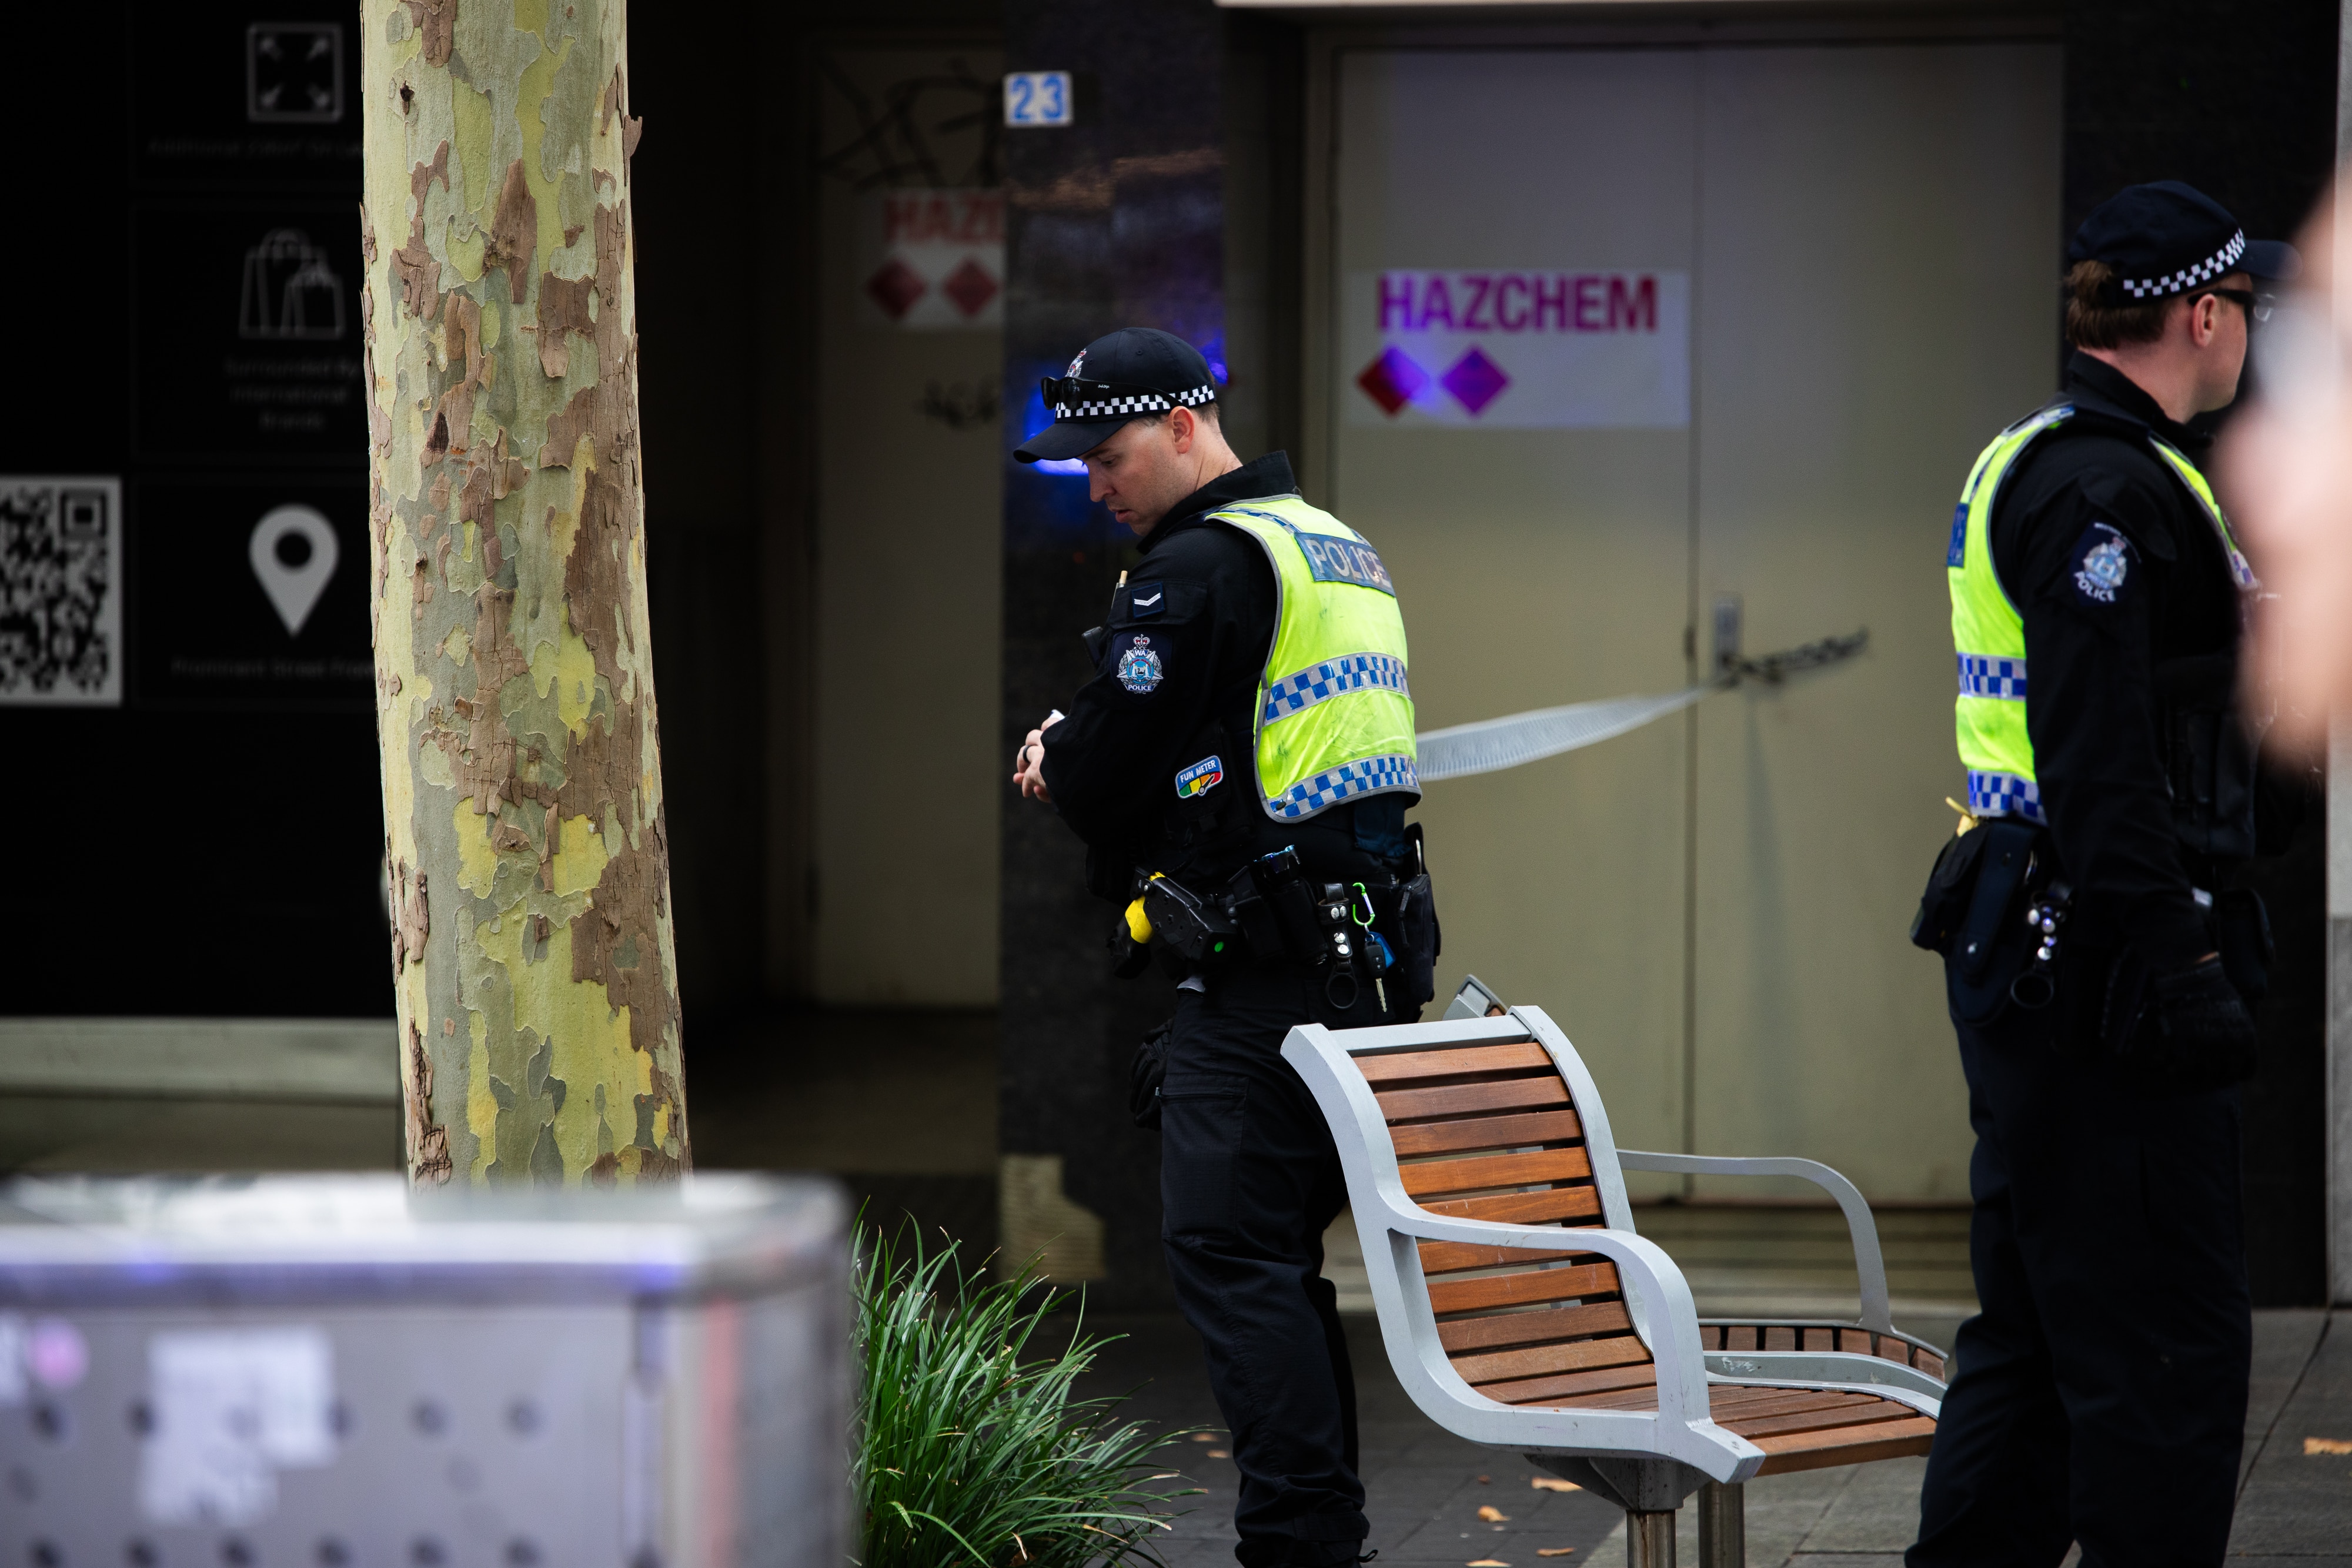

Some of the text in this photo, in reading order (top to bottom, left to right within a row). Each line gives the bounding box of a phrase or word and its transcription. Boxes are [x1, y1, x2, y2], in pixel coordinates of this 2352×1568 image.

[1011, 75, 1063, 120] 23
[884, 198, 1005, 243] HAZ
[1379, 274, 1656, 331] HAZCHEM
[1304, 539, 1392, 588] POLICE
[2073, 571, 2116, 602] POLICE
[1180, 760, 1216, 783] FUN METER
